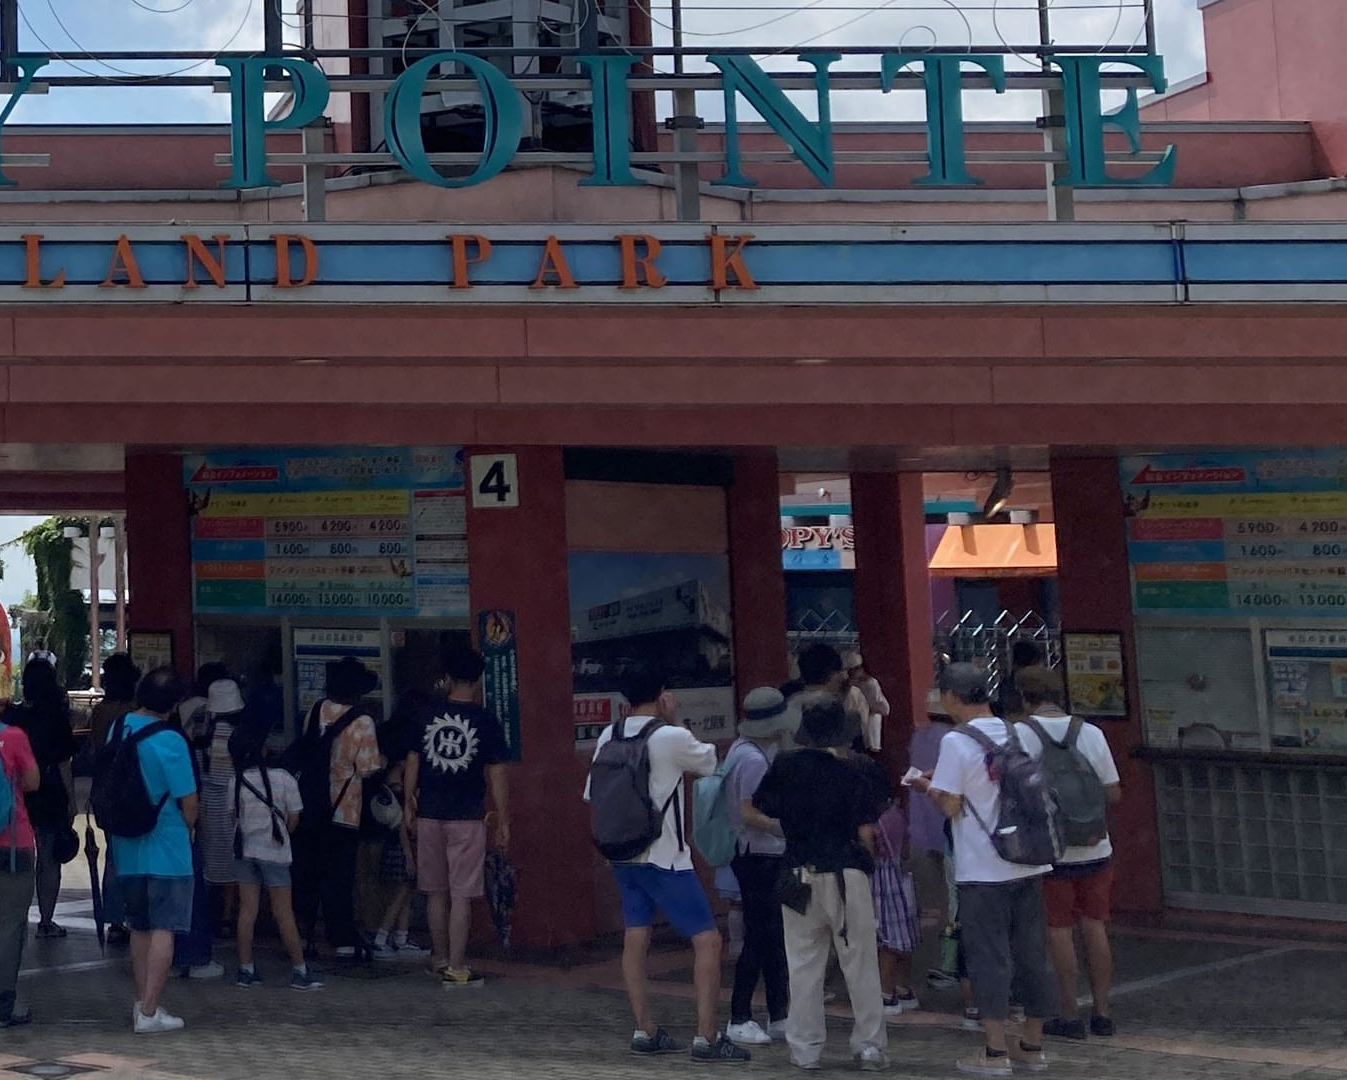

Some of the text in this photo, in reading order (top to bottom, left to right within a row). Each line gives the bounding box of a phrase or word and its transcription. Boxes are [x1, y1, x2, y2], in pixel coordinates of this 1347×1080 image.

[215, 51, 1177, 189] POINTE
[446, 233, 761, 291] PARK
[479, 460, 511, 501] 4
